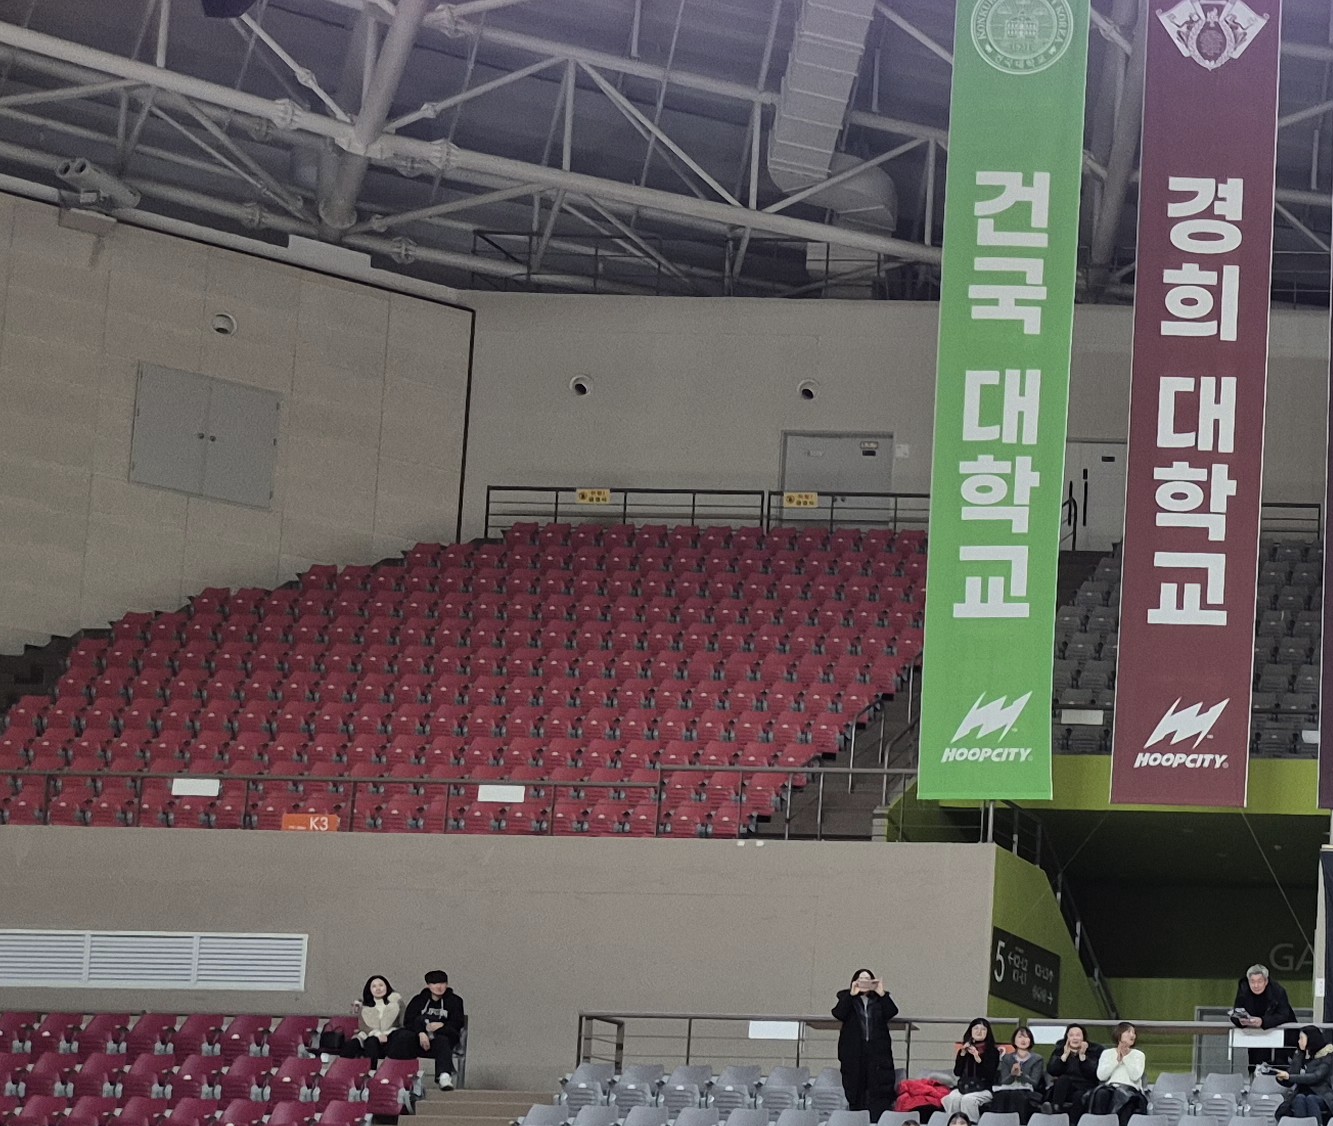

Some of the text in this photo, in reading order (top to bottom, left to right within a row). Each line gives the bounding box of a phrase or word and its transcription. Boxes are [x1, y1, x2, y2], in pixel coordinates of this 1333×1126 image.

[953, 171, 1050, 618] 건국 대학교
[1147, 177, 1243, 626] 경희 대학교
[941, 747, 1030, 763] HOOPCITY
[1133, 752, 1226, 769] HOOPCITY
[309, 816, 329, 831] K3
[994, 940, 1006, 982] 5
